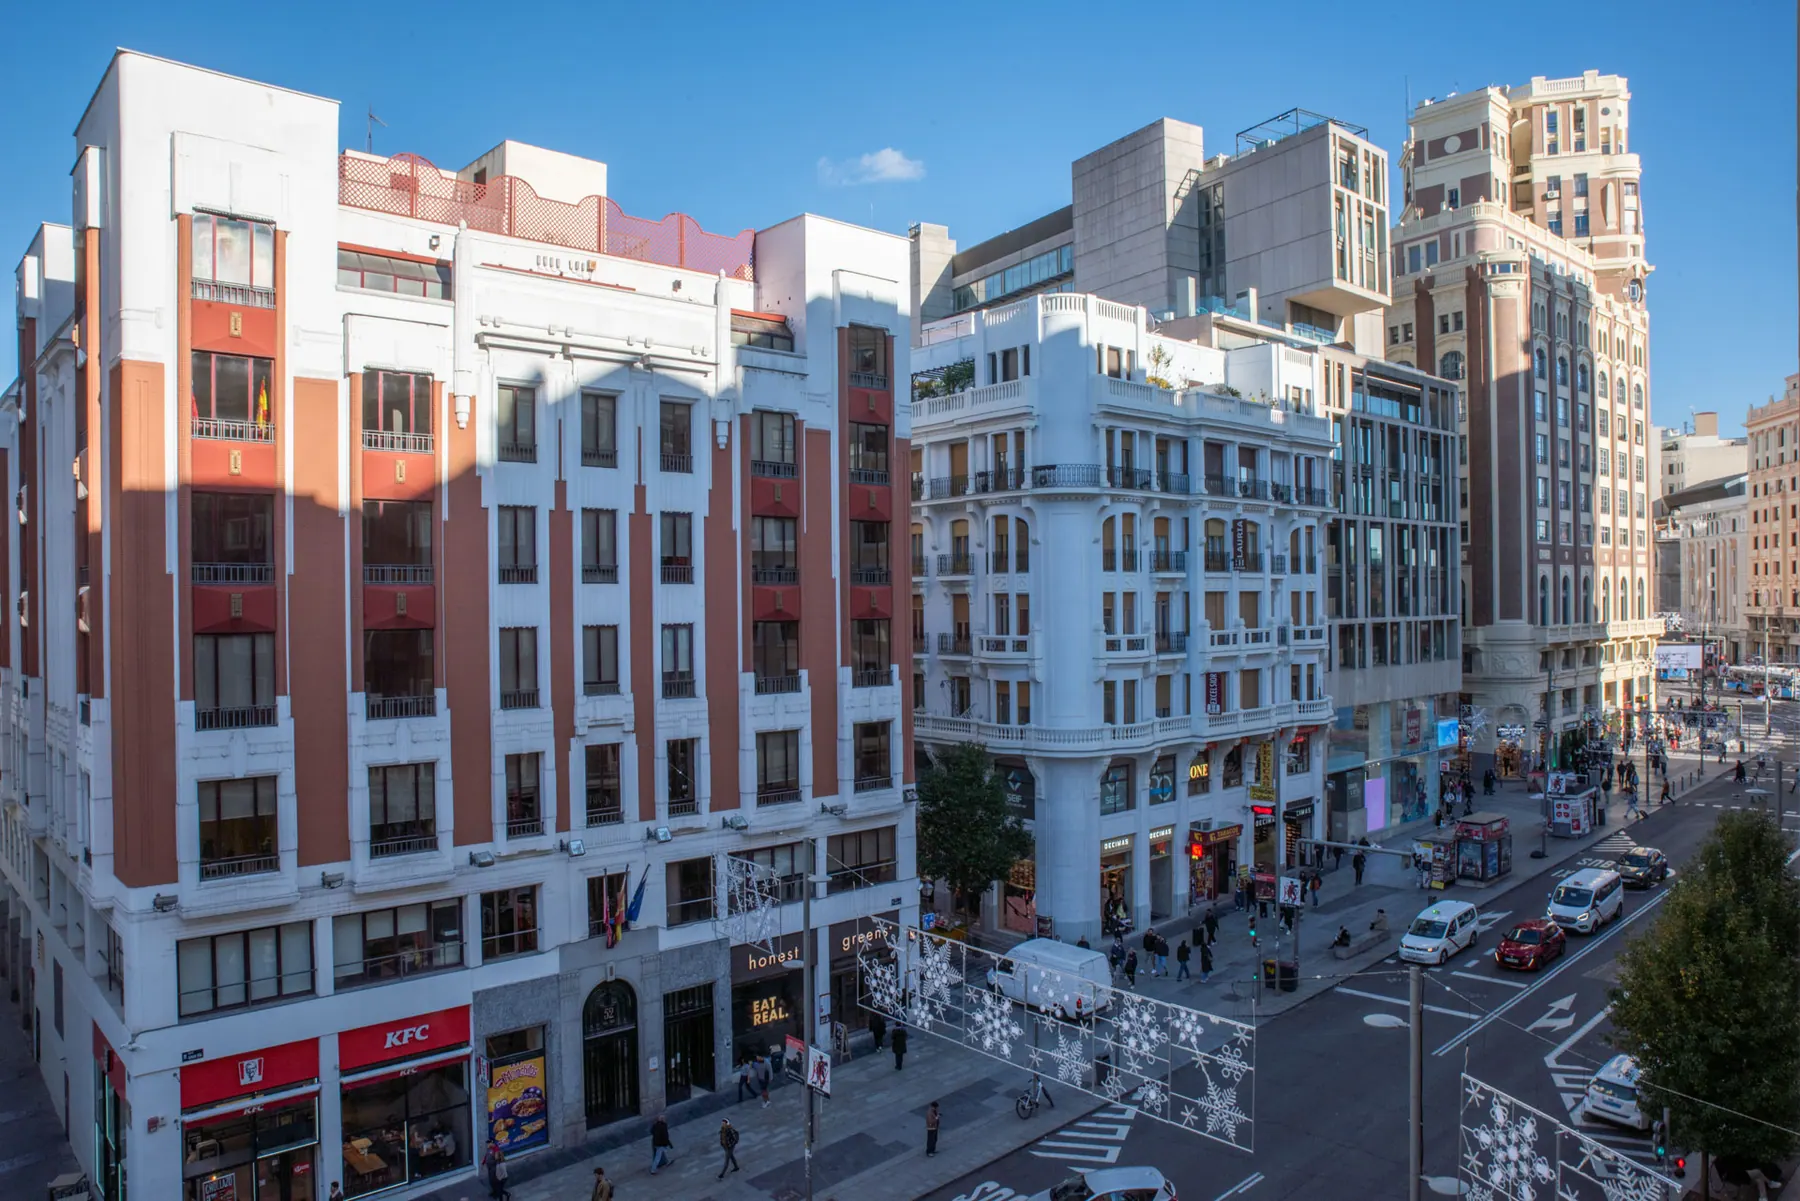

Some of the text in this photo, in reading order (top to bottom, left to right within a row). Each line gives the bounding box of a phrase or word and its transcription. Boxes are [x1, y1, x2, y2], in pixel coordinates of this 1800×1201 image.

[1236, 519, 1244, 558] LAURIA
[1210, 673, 1218, 705] EXCELSIOR
[1189, 763, 1209, 779] ONE
[1149, 828, 1172, 840] DECIMAS
[1104, 838, 1129, 850] DECIMAS
[748, 946, 799, 970] honest
[752, 996, 777, 1013] EAT
[603, 1007, 614, 1020] 52
[753, 1007, 789, 1026] REAL.
[383, 1024, 430, 1049] KFC
[400, 1067, 418, 1076] KFC
